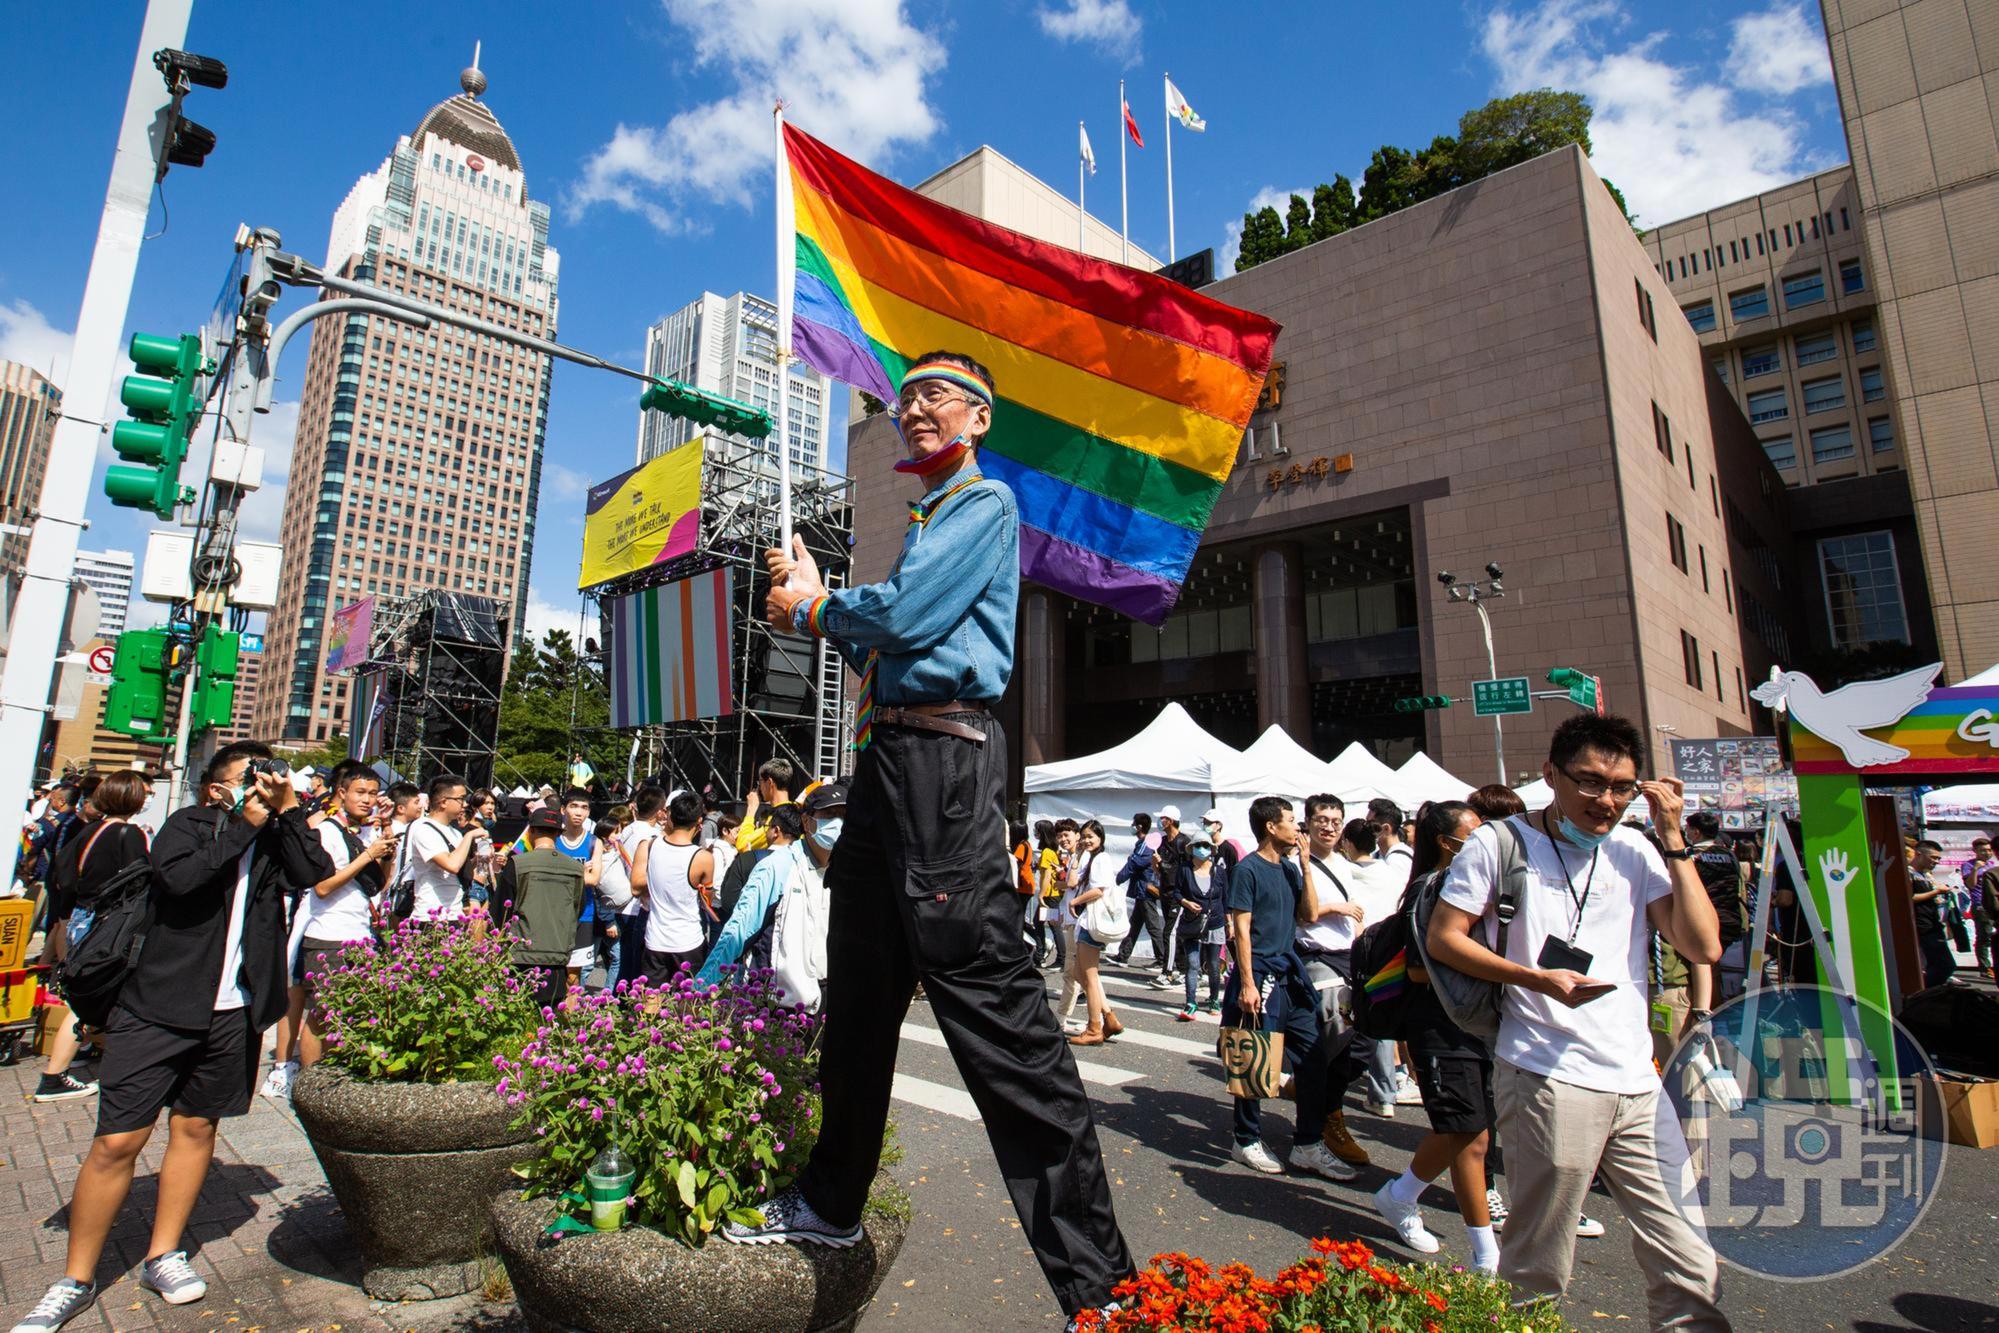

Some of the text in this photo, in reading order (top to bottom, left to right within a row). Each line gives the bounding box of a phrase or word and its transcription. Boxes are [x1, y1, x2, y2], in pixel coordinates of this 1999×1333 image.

[1246, 421, 1288, 462] LL
[1680, 745, 1713, 759] 好人
[1682, 758, 1715, 774] 之家
[2, 917, 17, 945] SUAN
